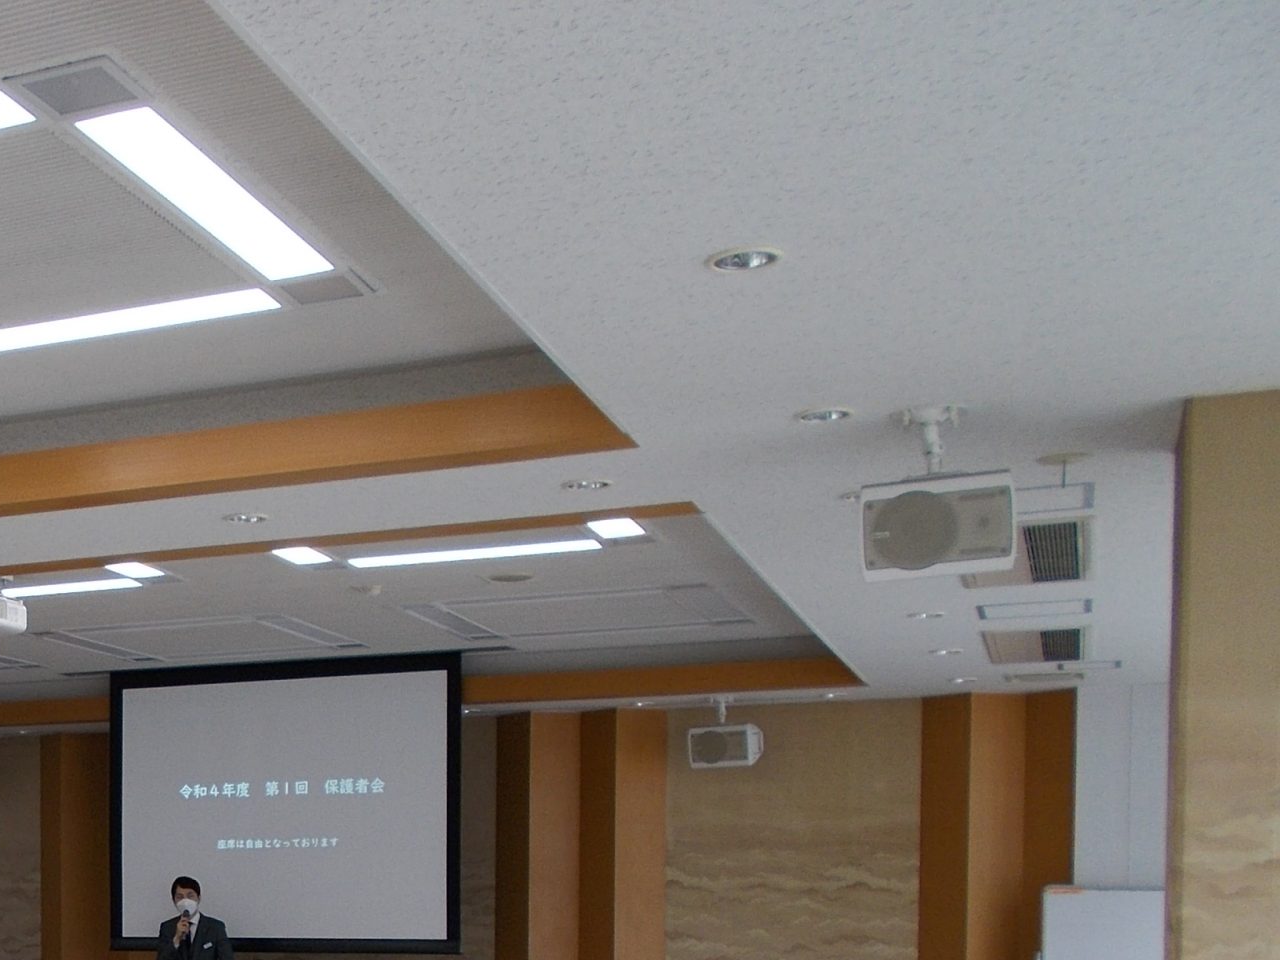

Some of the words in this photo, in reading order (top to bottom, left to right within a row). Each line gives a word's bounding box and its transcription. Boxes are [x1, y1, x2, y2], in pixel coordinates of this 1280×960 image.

[179, 782, 250, 799] 令和4年度
[265, 780, 309, 797] 第1回
[324, 777, 385, 795] 保護者会
[217, 837, 339, 850] 座席は自由となっております
